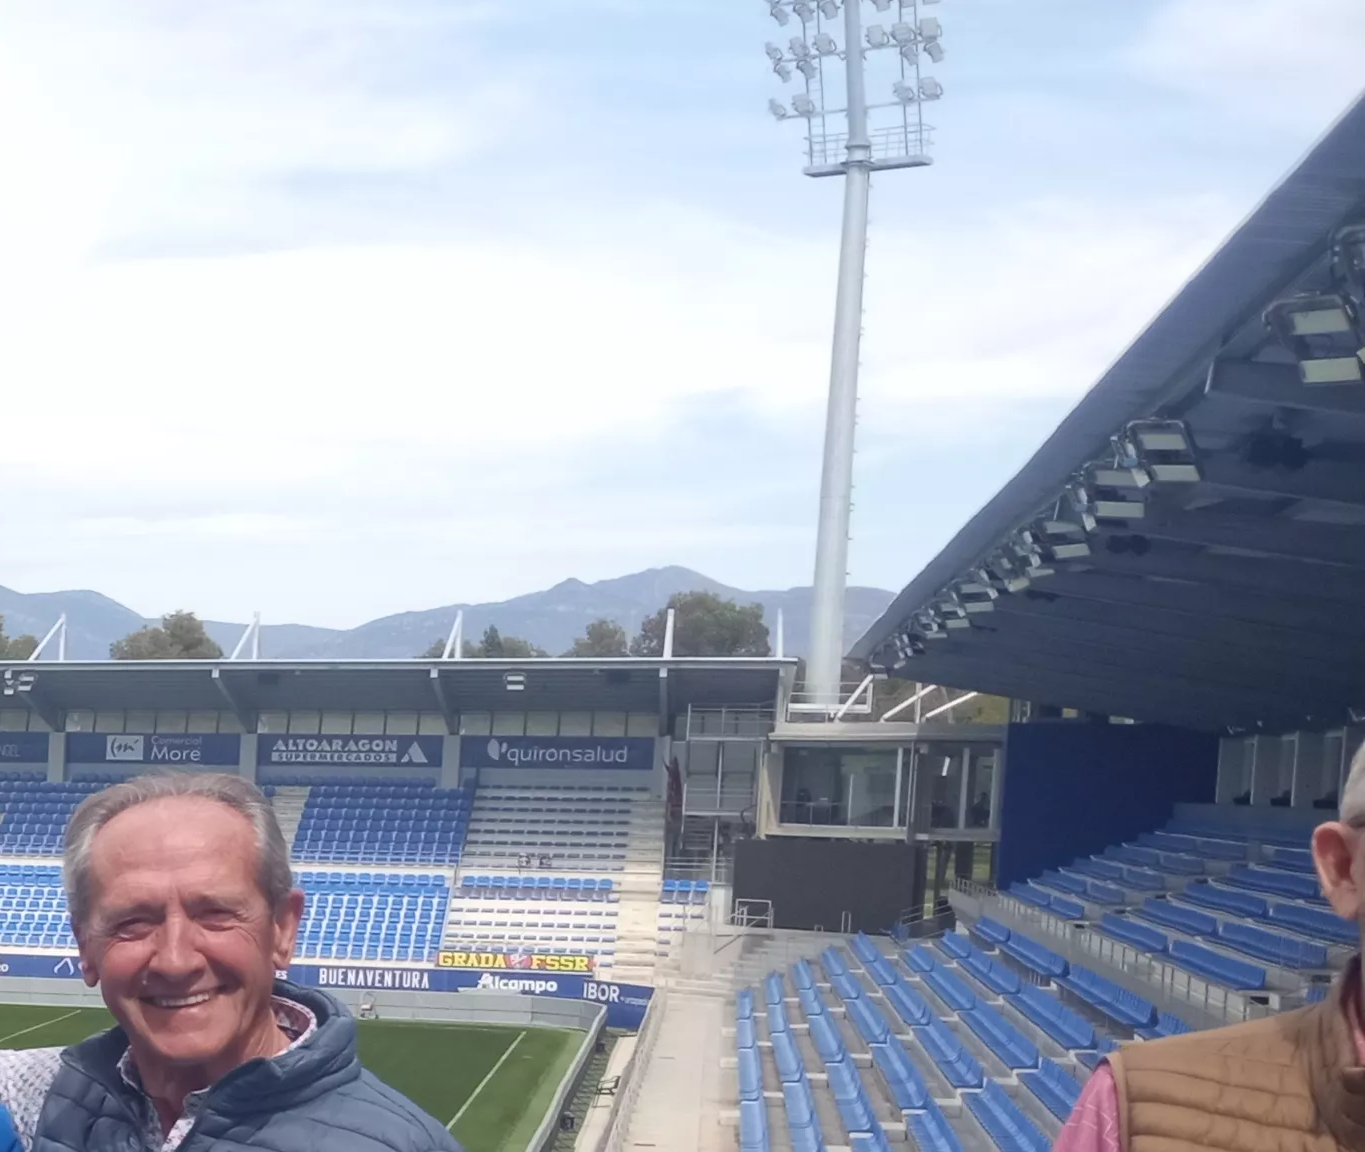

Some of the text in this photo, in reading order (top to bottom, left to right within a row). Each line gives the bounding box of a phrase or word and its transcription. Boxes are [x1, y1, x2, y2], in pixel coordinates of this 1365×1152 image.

[151, 735, 202, 745] Comercial
[278, 753, 391, 761] SUPERMERCADOS
[438, 952, 507, 968] GRADA
[319, 967, 429, 989] BUENAVENTURA
[477, 973, 558, 994] Alcampo
[583, 982, 620, 1003] IBOR
